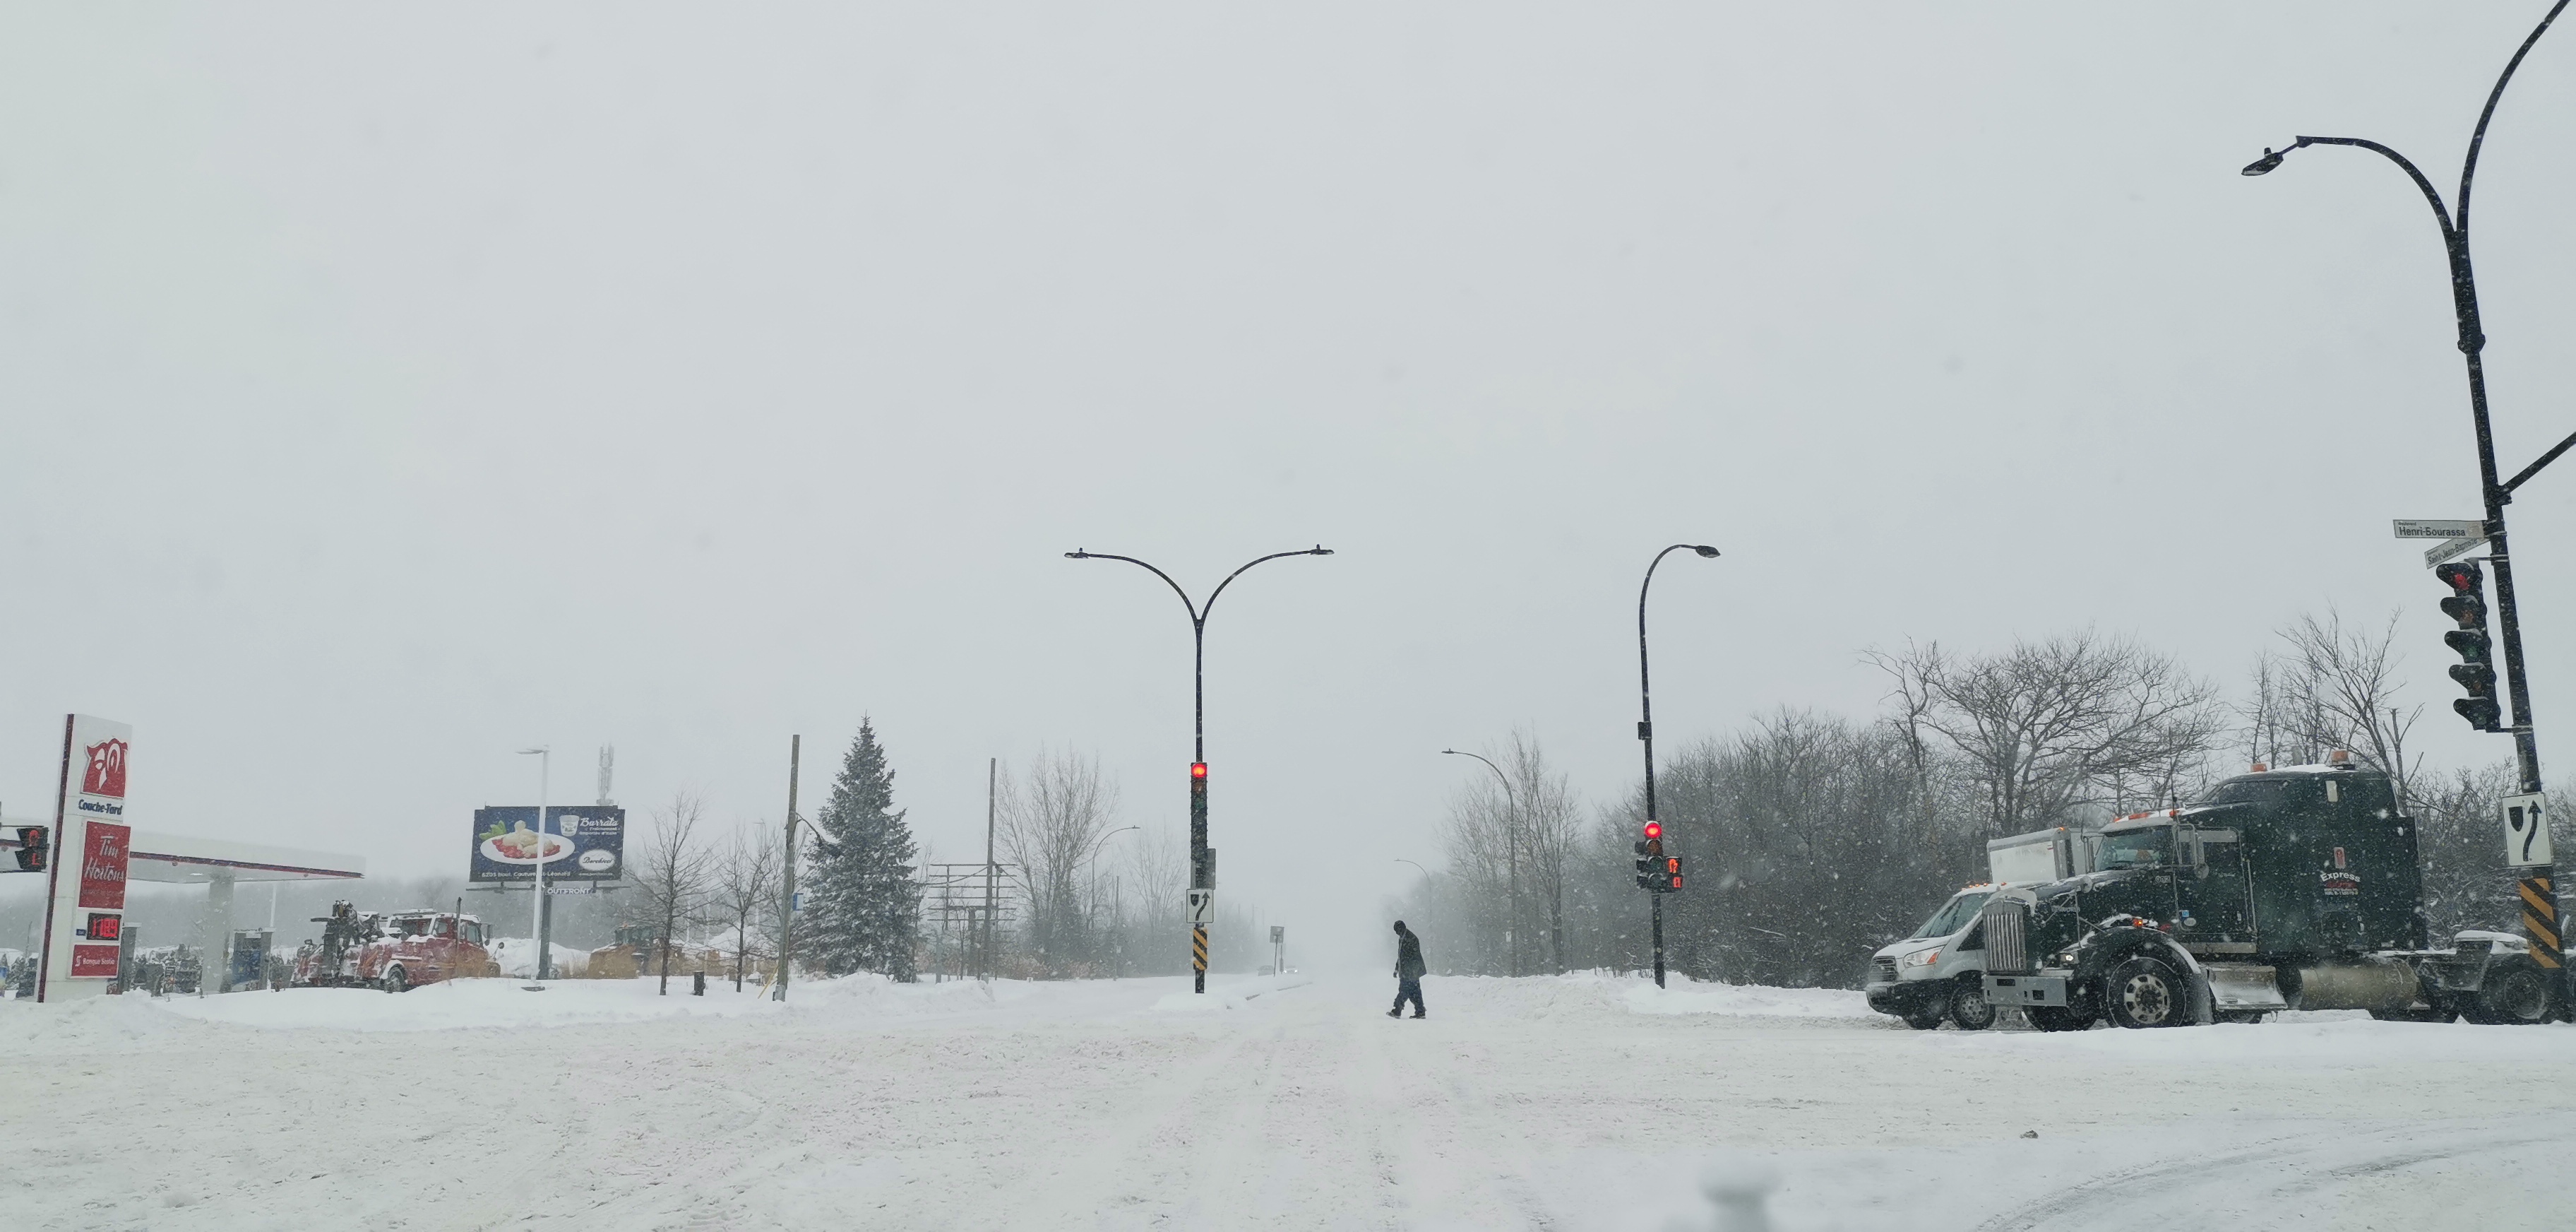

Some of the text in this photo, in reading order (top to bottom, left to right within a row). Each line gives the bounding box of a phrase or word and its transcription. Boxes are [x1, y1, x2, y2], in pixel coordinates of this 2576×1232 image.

[2399, 526, 2465, 536] Henri-Bourassa
[78, 799, 122, 815] Couche-Tard
[100, 835, 119, 858] Tim
[84, 856, 125, 882] Hortons
[2320, 872, 2361, 882] Express
